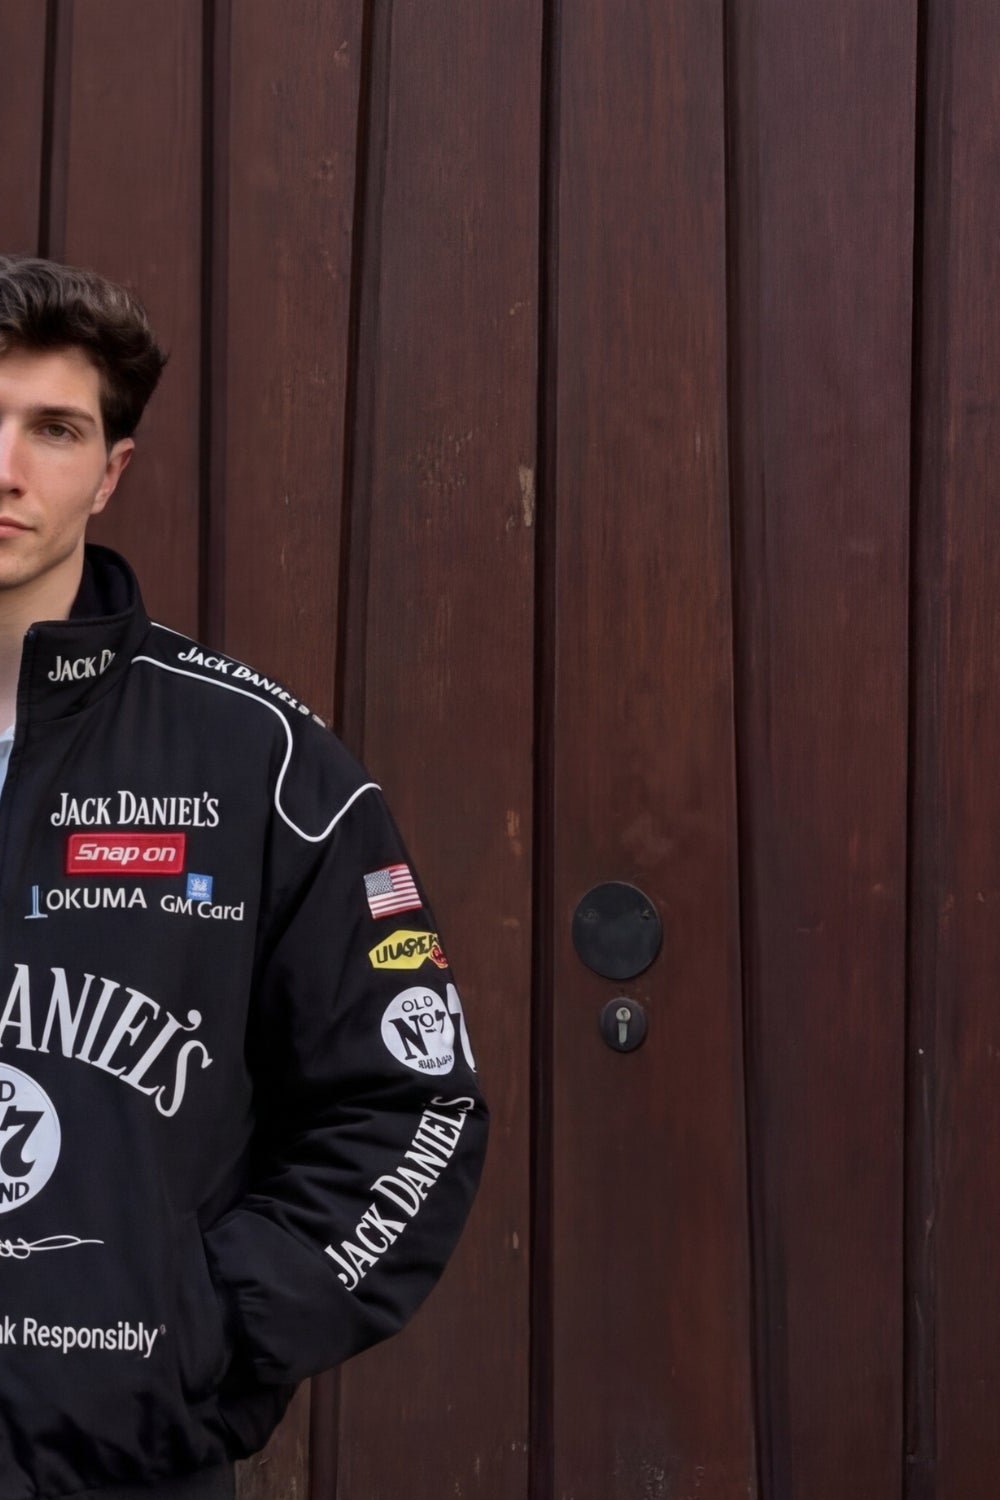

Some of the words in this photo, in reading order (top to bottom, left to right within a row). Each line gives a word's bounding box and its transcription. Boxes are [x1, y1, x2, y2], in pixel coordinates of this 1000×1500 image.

[48, 655, 96, 681] JACK
[177, 647, 233, 674] JACK
[50, 792, 112, 827] JACK
[117, 790, 219, 827] DANIEL'S
[74, 843, 140, 865] Snap
[142, 847, 176, 862] on
[46, 887, 147, 911] OKUMA
[160, 895, 193, 916] GM
[197, 901, 245, 921] Card
[402, 996, 433, 1013] OLD
[0, 1105, 45, 1178] 7
[324, 1203, 407, 1291] JACK
[23, 1317, 159, 1358] Responsibly
